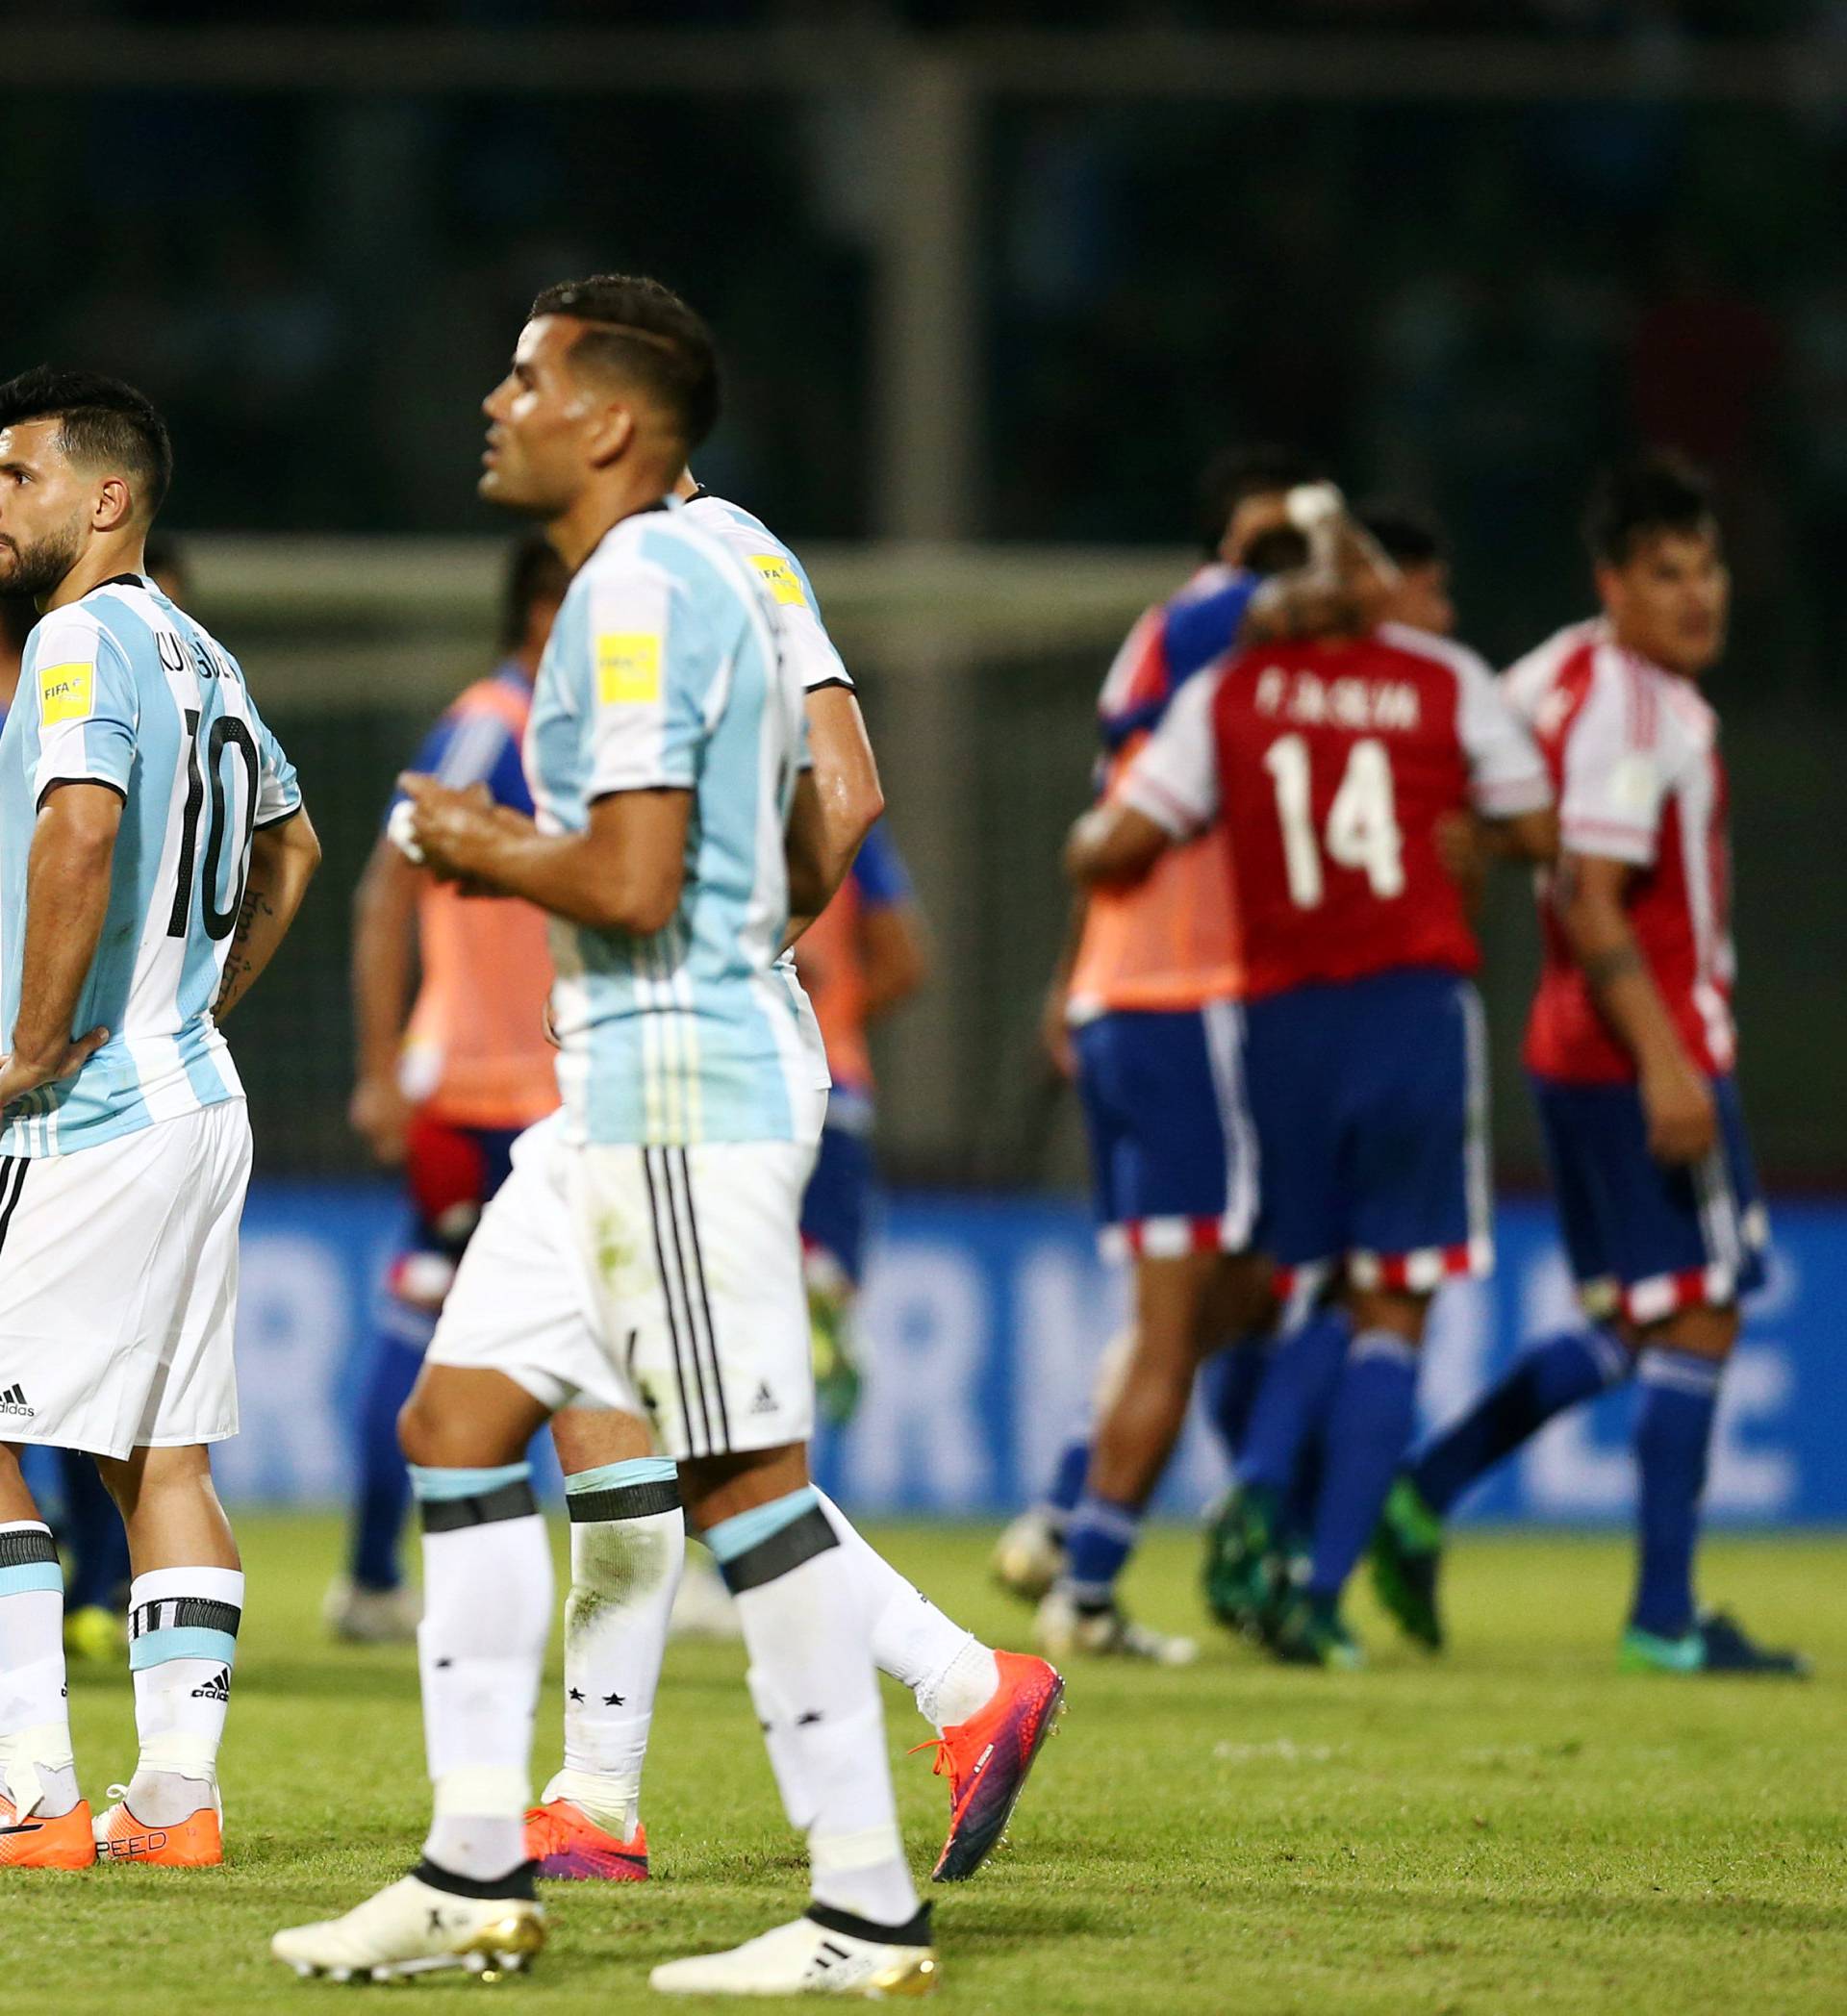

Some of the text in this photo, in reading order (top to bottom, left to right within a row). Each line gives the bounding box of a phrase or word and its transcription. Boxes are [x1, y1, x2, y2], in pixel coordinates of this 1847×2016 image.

[44, 681, 70, 700] FIFA
[166, 708, 261, 942] 10
[1263, 733, 1405, 910] 14
[0, 1401, 35, 1417] didas
[94, 1831, 166, 1859] PEED
